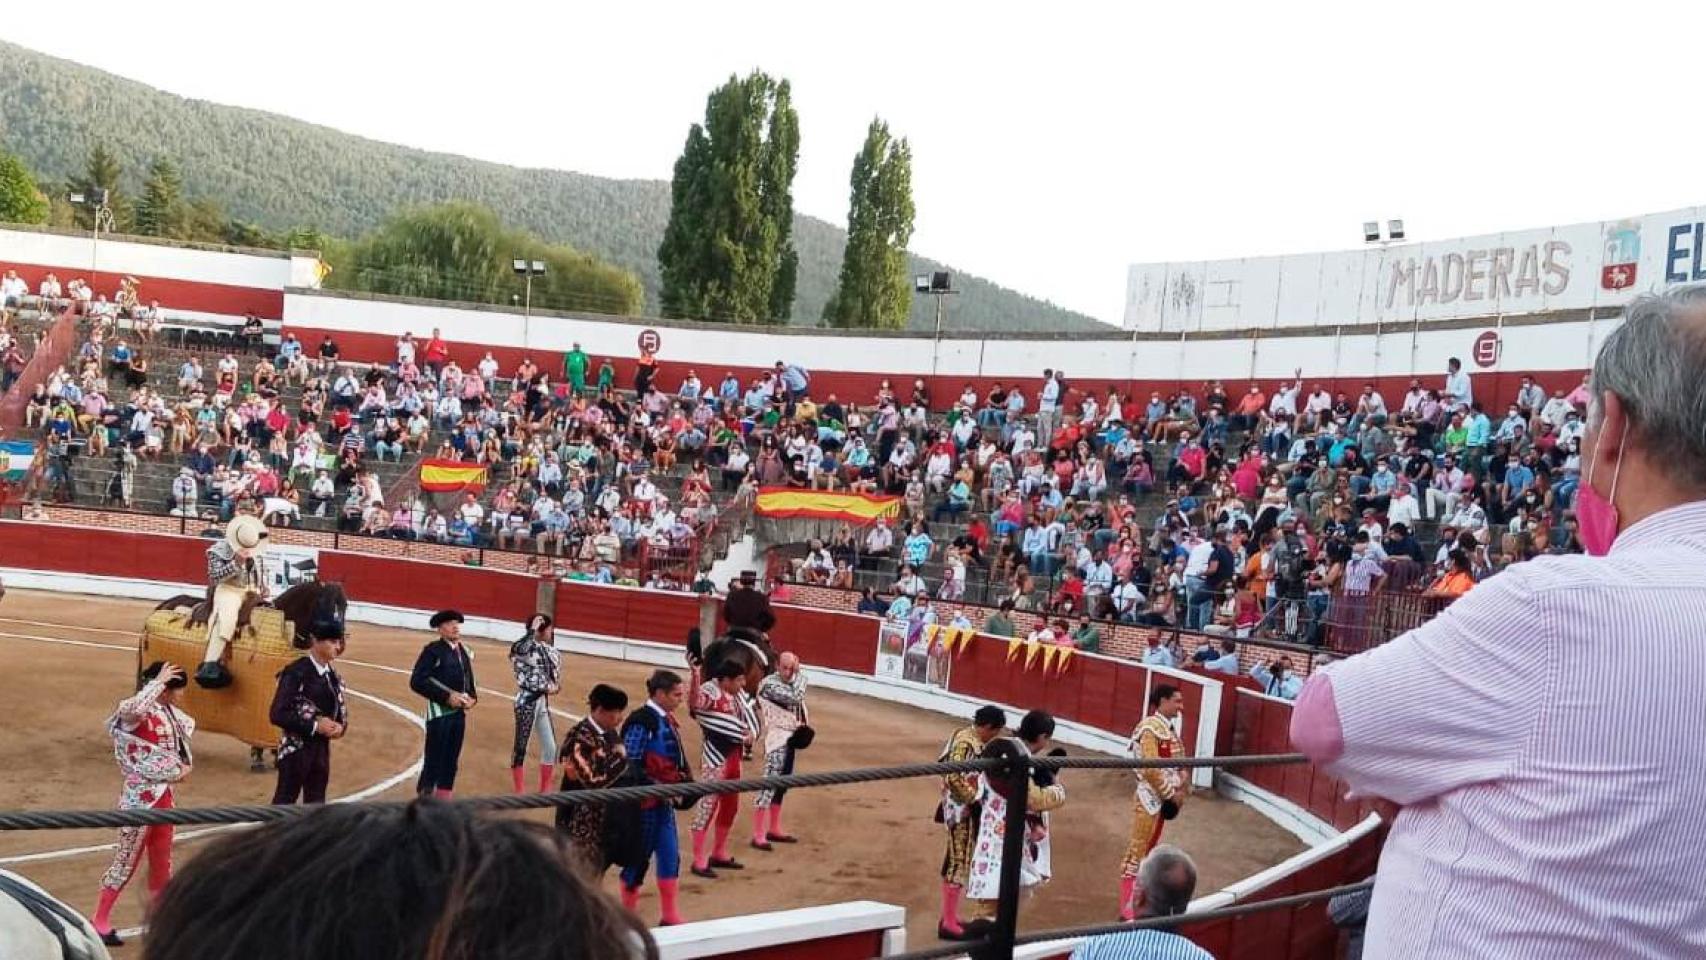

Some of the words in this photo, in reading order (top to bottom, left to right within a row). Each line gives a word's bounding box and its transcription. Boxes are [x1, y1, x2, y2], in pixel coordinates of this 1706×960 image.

[1385, 241, 1571, 309] MADERAS
[1666, 222, 1706, 282] EL
[1478, 339, 1496, 361] 9
